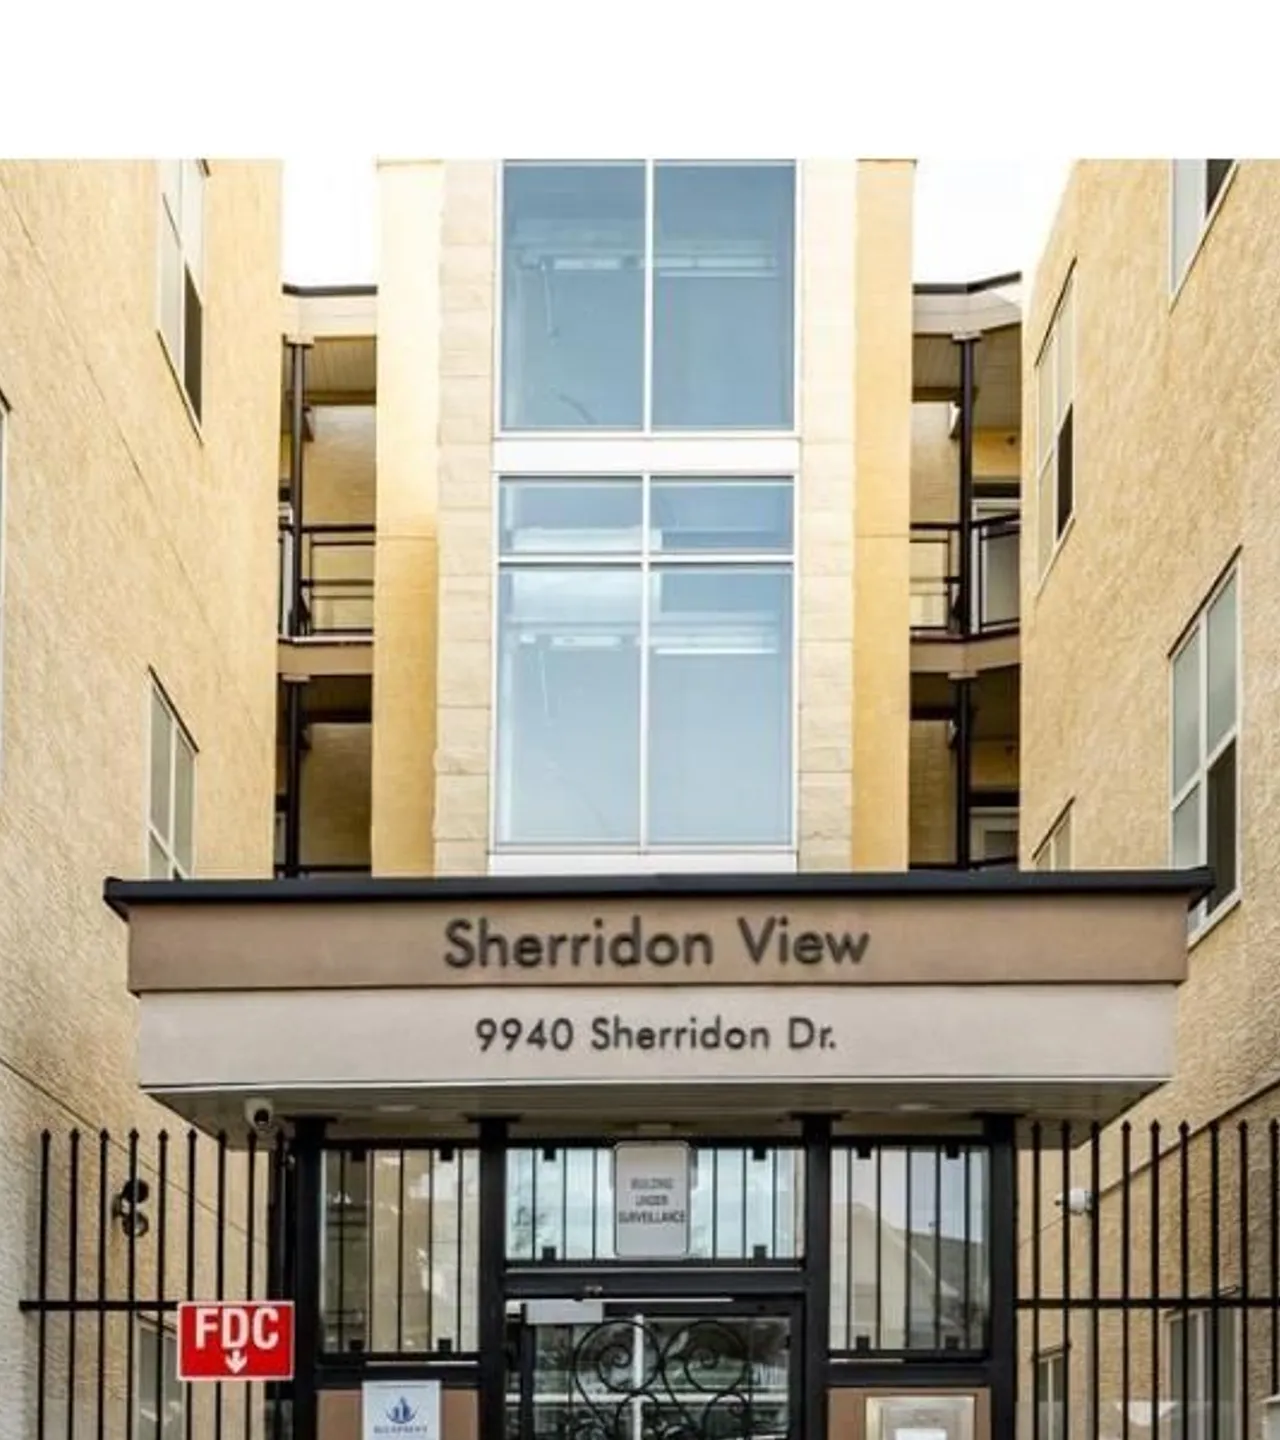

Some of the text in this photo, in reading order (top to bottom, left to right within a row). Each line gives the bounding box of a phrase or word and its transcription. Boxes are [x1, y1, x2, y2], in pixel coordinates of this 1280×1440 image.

[444, 916, 870, 968] Sherridon View
[475, 1014, 836, 1051] 9940 Sherridon Dr.
[195, 1307, 279, 1350] FDC
